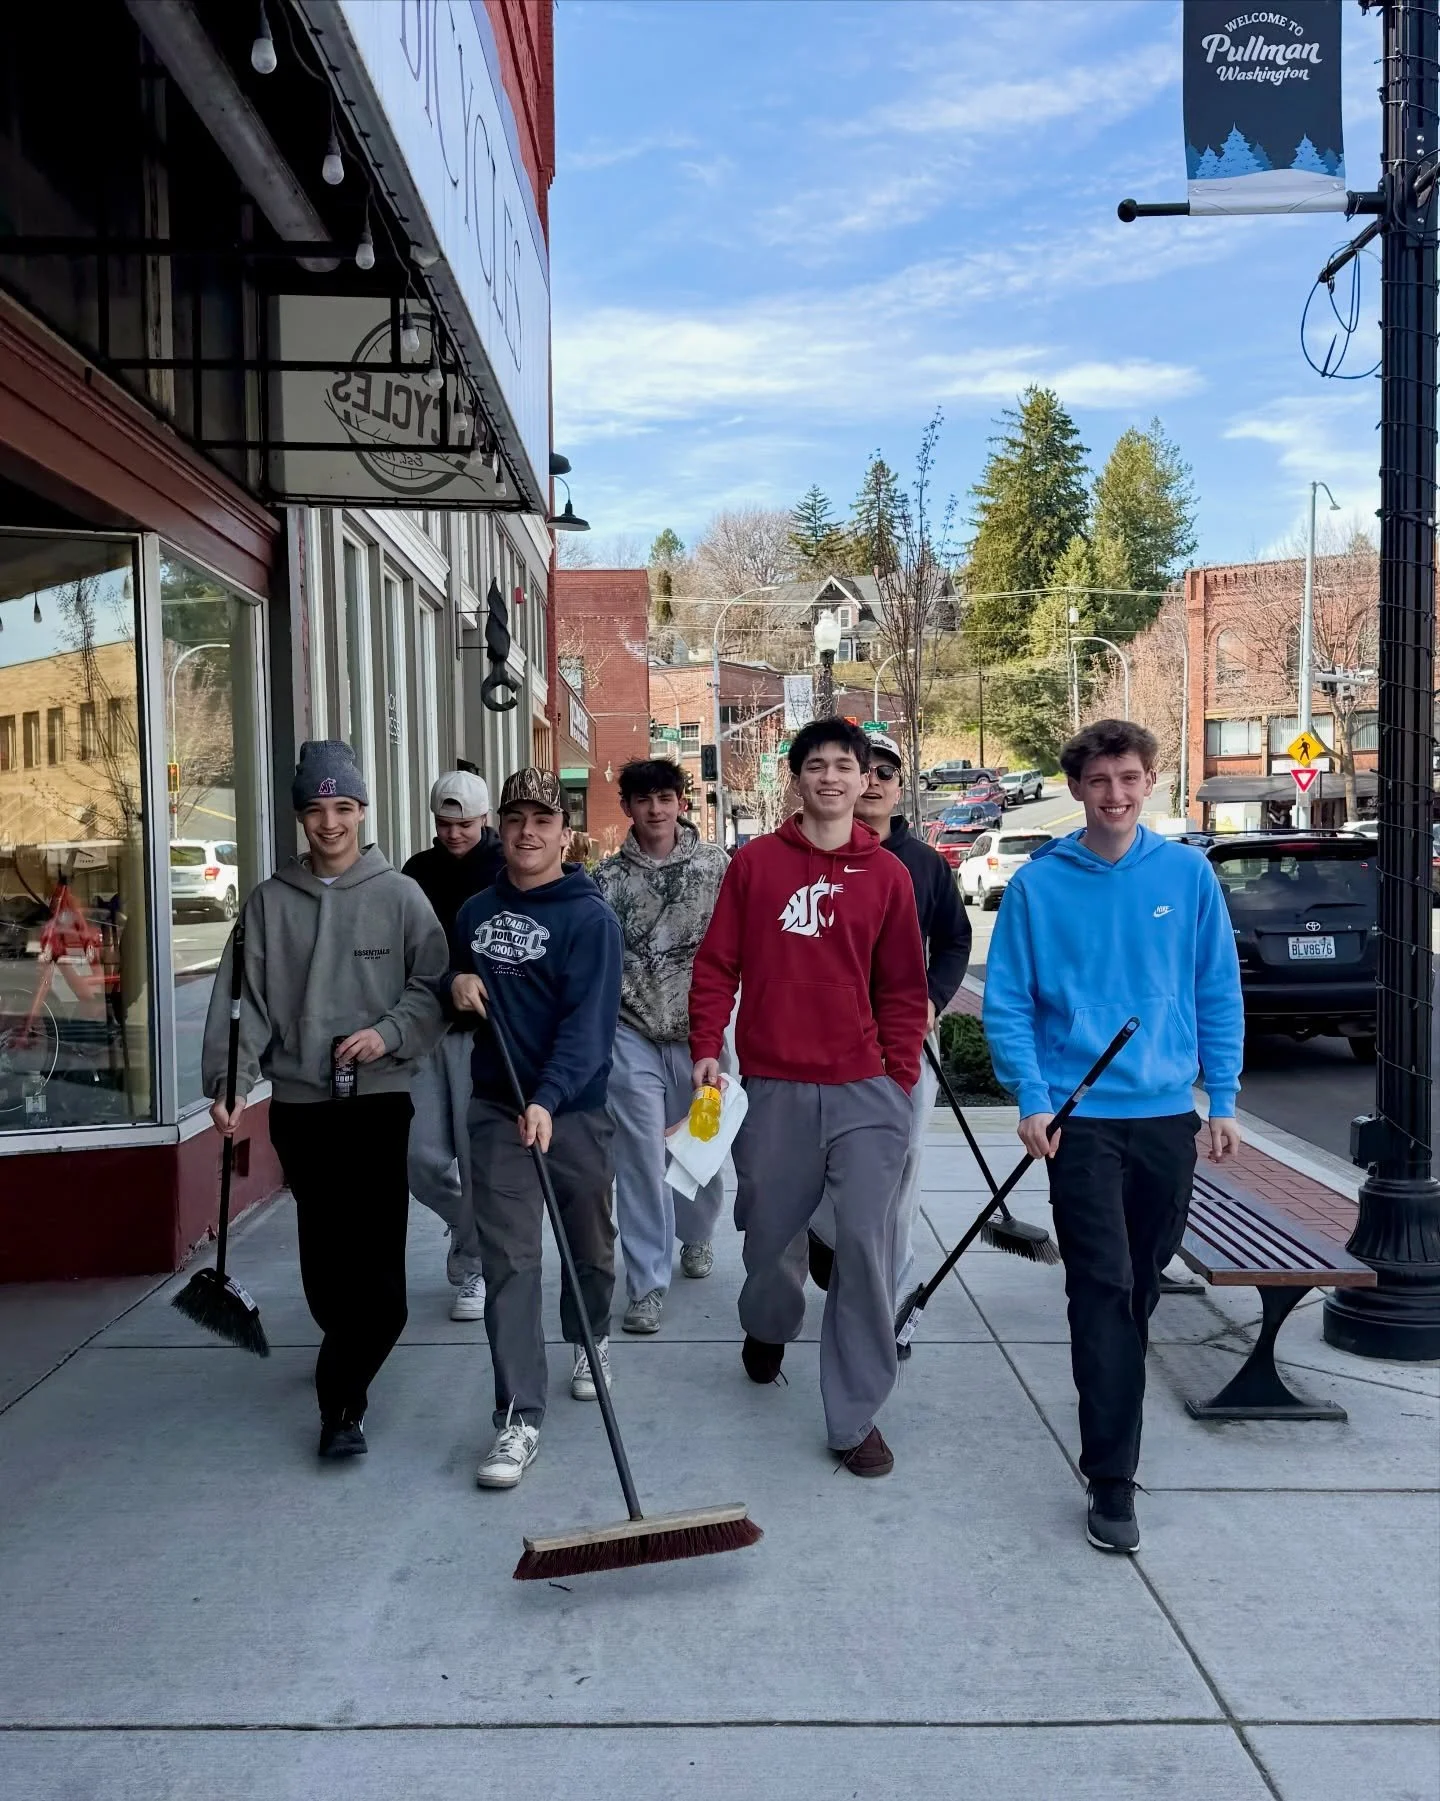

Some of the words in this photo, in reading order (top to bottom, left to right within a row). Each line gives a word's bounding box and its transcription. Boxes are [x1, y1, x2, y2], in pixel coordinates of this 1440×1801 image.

[1224, 12, 1288, 33] WELCOME
[1289, 20, 1304, 37] TO
[1201, 33, 1323, 66] Pullman
[1216, 65, 1310, 86] Washington
